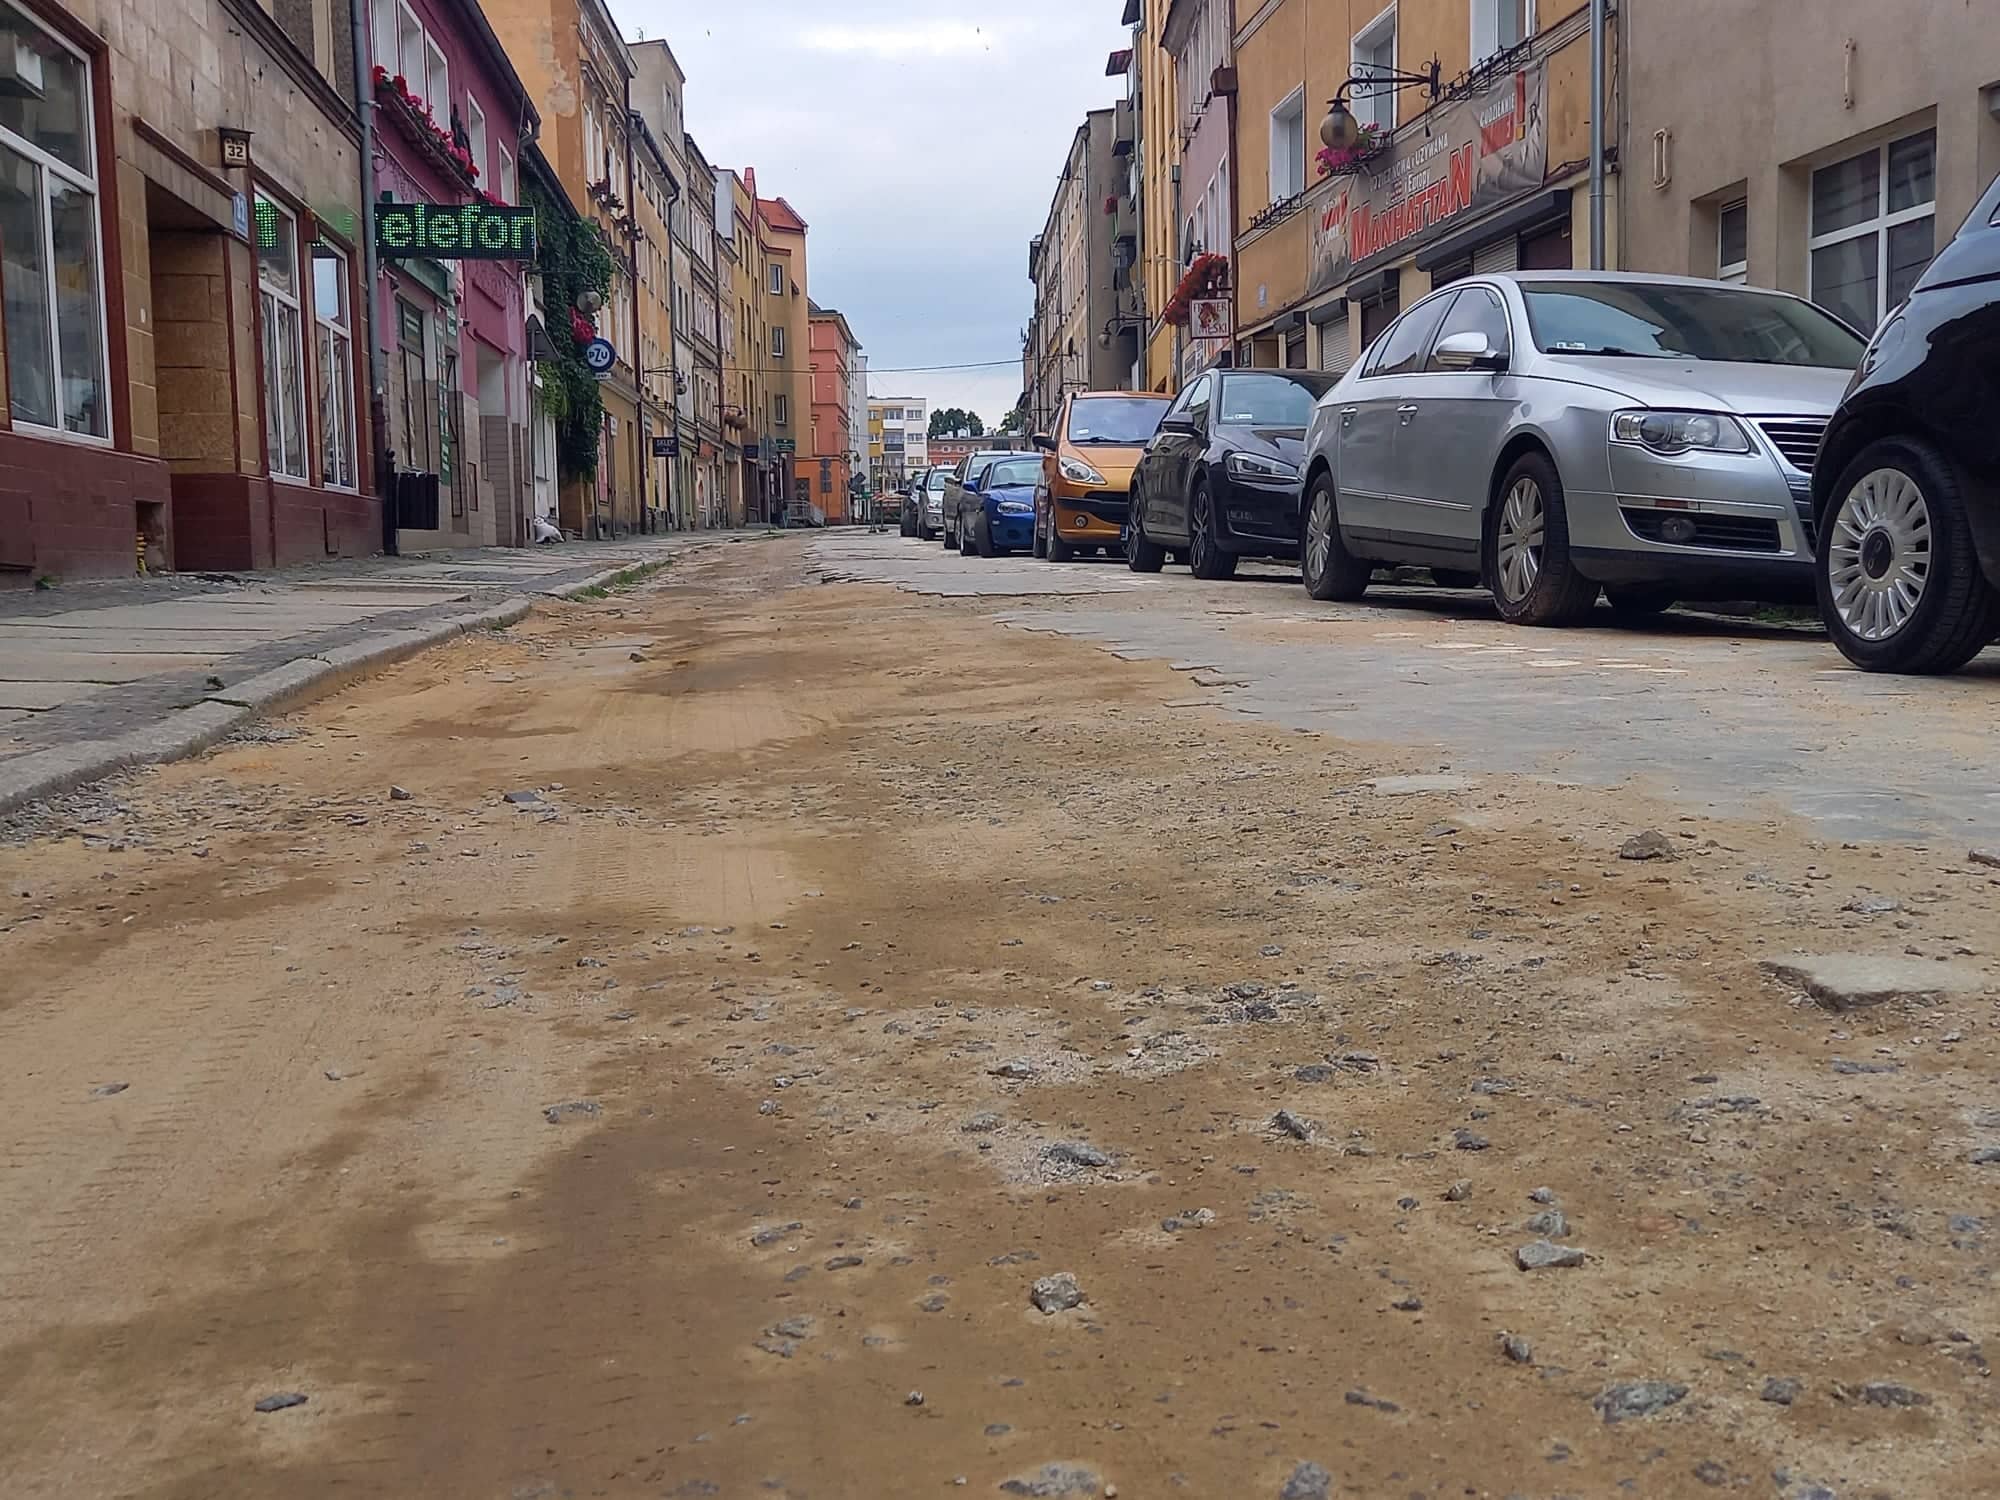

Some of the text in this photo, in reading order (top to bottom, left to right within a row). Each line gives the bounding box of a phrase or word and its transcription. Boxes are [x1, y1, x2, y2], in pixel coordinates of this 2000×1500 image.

[228, 145, 244, 157] 32
[1351, 140, 1473, 265] MANHATTAN
[375, 203, 534, 248] elefon
[588, 348, 608, 362] PZU
